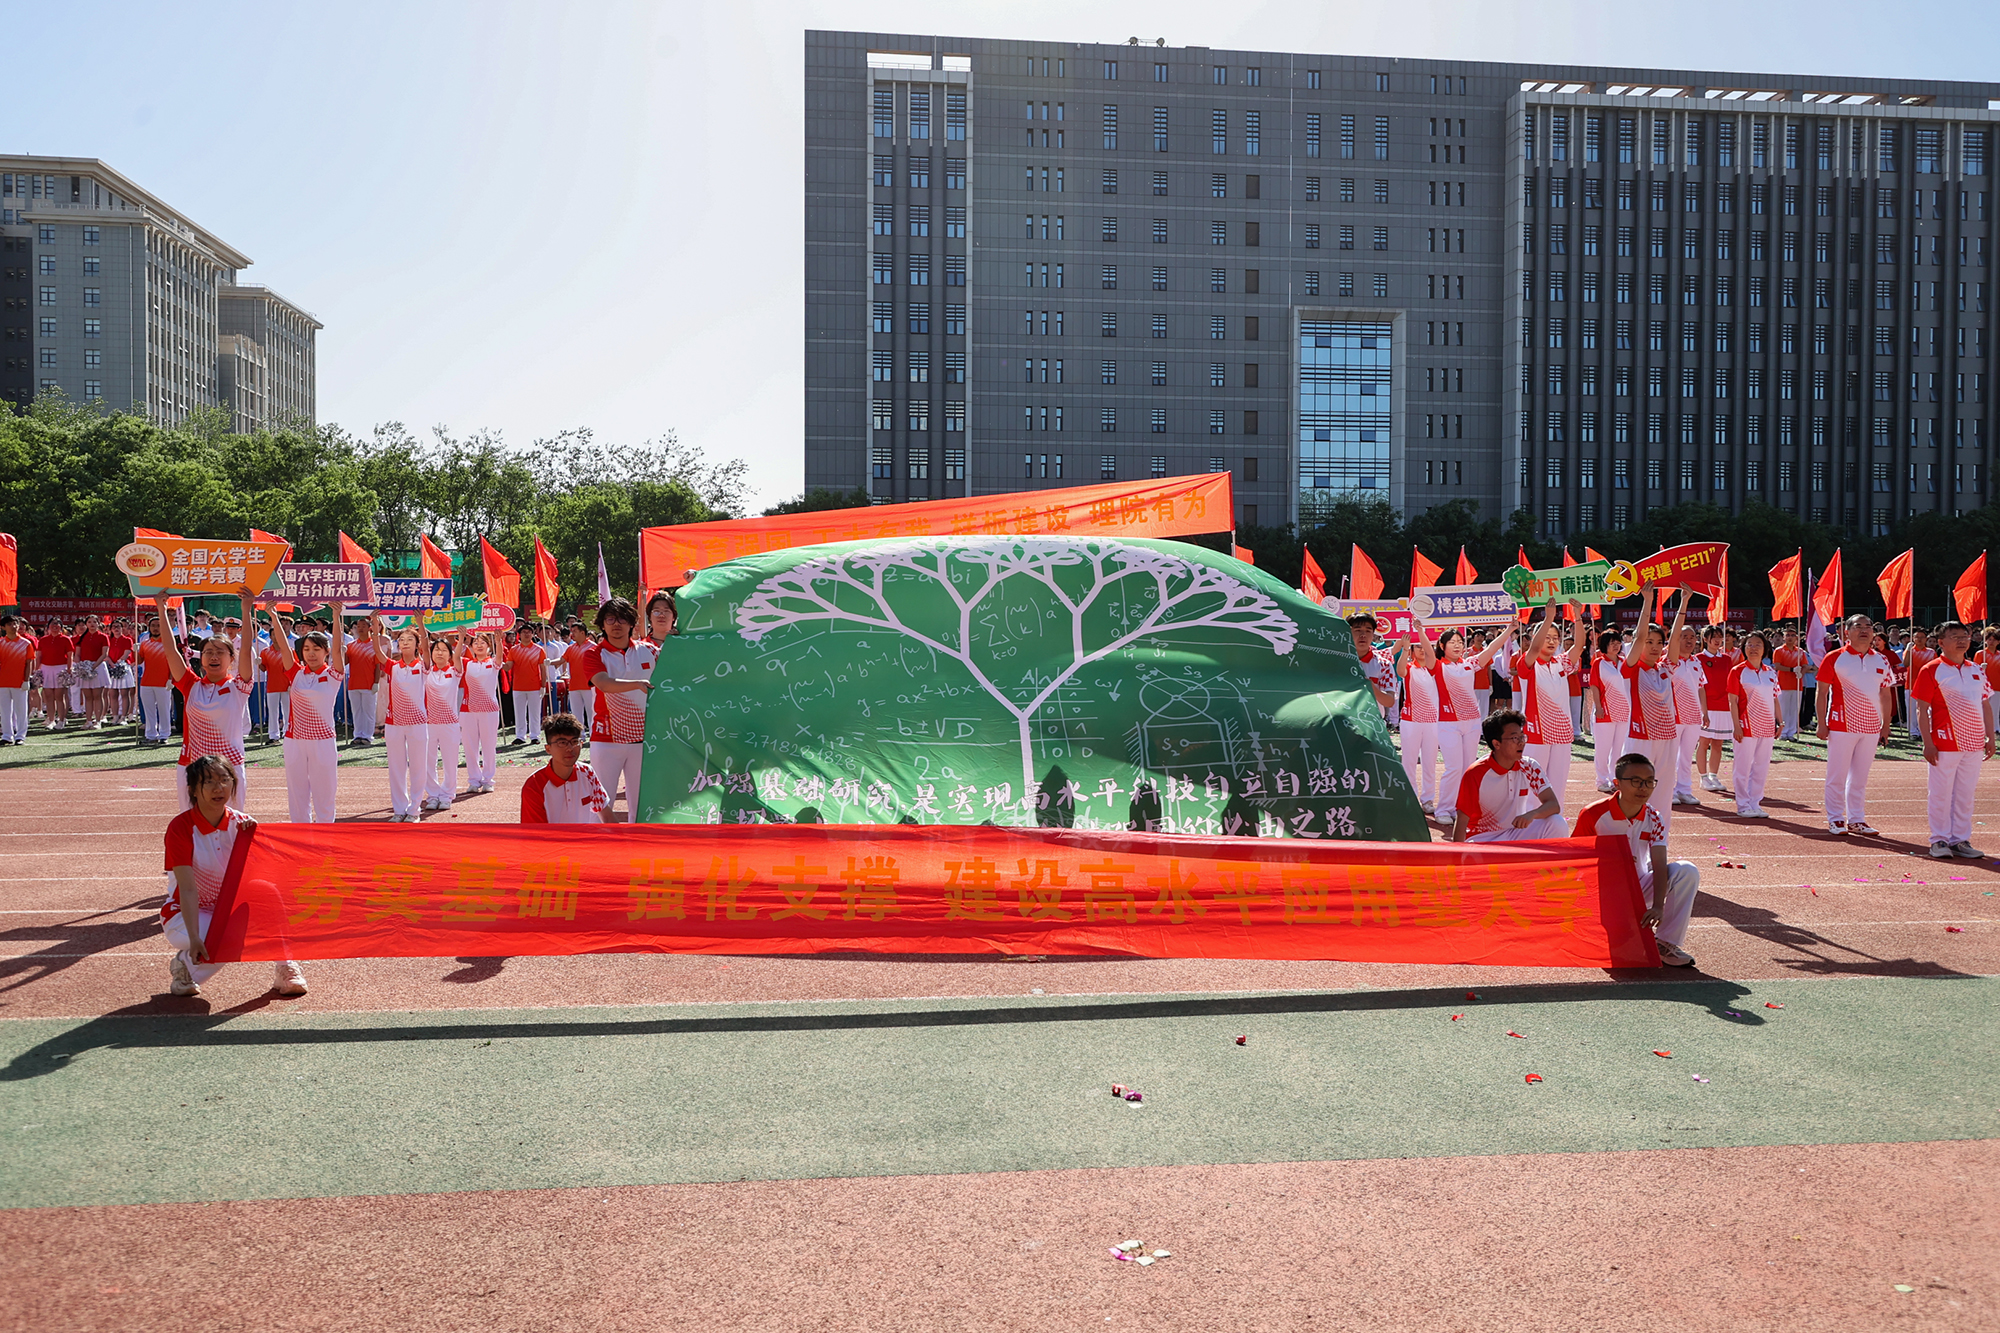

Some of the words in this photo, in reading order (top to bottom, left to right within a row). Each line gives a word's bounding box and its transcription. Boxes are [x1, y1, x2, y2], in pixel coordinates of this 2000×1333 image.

[1088, 488, 1206, 527] 理院有为
[171, 547, 266, 566] 全国大学生
[171, 566, 247, 586] 数学竞赛
[1437, 594, 1513, 614] 棒垒球联赛
[288, 856, 582, 926] 夯实基础
[626, 855, 902, 924] 强化支撑
[943, 856, 1591, 932] 建设高水平应用型大学
